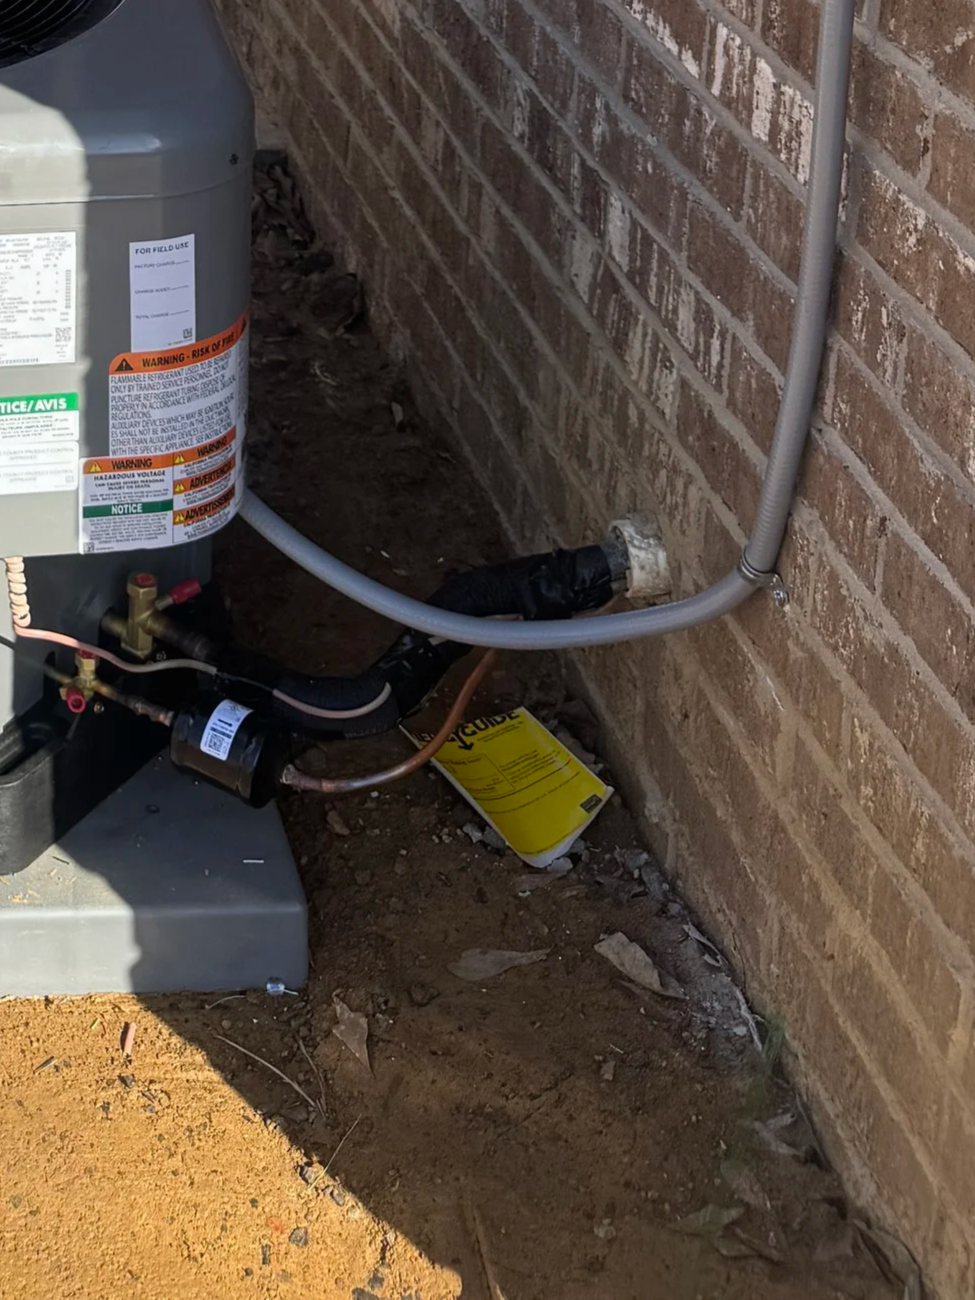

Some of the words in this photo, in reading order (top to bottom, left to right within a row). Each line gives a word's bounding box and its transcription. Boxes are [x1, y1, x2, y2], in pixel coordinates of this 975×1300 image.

[135, 247, 151, 255] FOR
[153, 245, 174, 253] FIELD
[175, 242, 189, 250] USE
[142, 353, 185, 368] WARNING
[191, 346, 210, 359] RISK
[211, 342, 221, 352] OF
[221, 332, 235, 348] FIRE
[111, 374, 146, 384] FLAMMABLE
[147, 368, 184, 381] REFRIGERANT
[111, 384, 126, 394] ONLY
[127, 384, 135, 393] BY
[136, 382, 161, 392] TRAINED
[161, 377, 183, 390] SERVICE
[111, 394, 142, 403] PUNCTURE
[143, 389, 181, 402] REFRIGERANT
[111, 403, 140, 412] PROPERLY
[141, 402, 147, 410] IN
[147, 396, 186, 410] ACCORDANCE
[186, 393, 199, 403] WITH
[111, 420, 141, 429] AUXILIARY
[142, 418, 165, 428] DEVICES
[166, 414, 184, 425] WHICH
[185, 411, 196, 420] MAY
[197, 408, 203, 417] BE
[111, 430, 118, 438] ES
[119, 429, 137, 438] SHALL
[138, 428, 151, 436] NOT
[152, 427, 159, 435] BE
[160, 422, 188, 434] INSTALLED
[111, 438, 131, 447] OTHER
[131, 437, 148, 446] THAN
[149, 433, 177, 444] AUXILIARY
[178, 428, 199, 440] DEVICES
[111, 447, 127, 456] WITH
[127, 446, 138, 455] THE
[139, 444, 164, 455] SPECIFIC
[197, 435, 228, 457] WARNING
[111, 459, 153, 470] WARNING
[93, 471, 135, 481] HAZARDOUS
[137, 470, 166, 478] VOLTAGE
[111, 503, 143, 515] NOTICE
